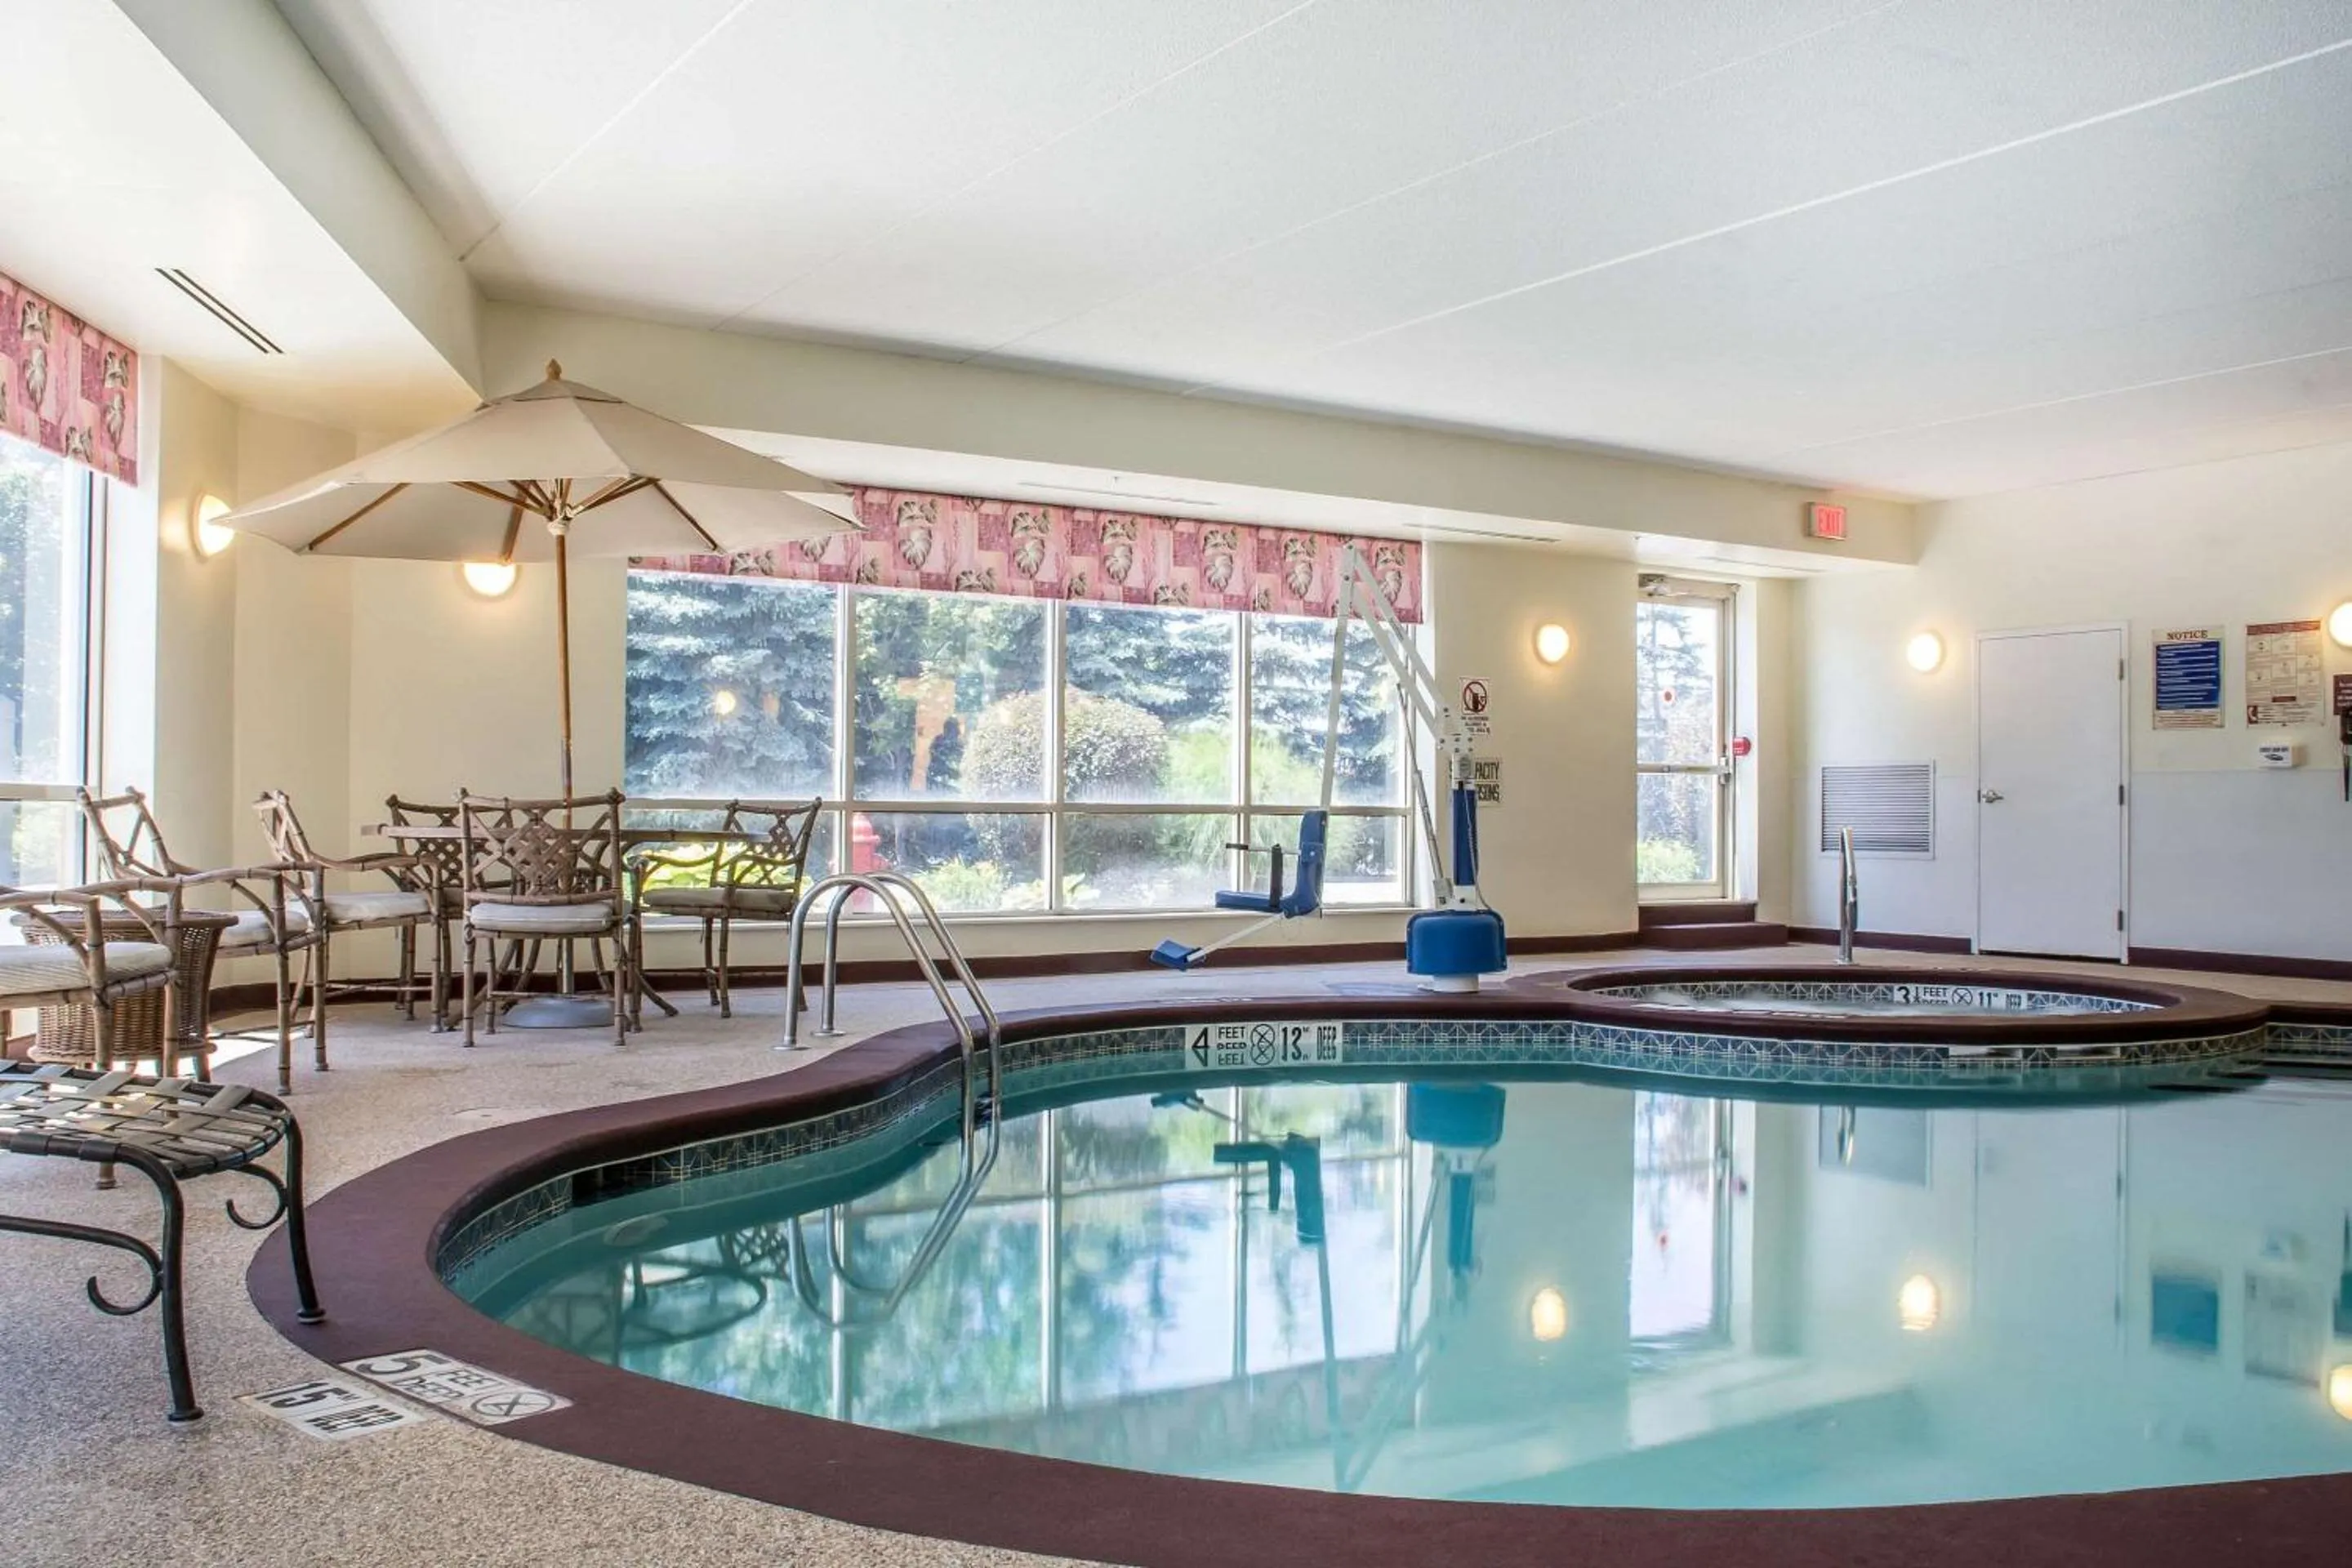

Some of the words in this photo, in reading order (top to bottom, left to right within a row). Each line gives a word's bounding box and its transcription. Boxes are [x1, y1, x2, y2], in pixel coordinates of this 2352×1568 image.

[1817, 508, 1842, 534] EXIT
[2167, 630, 2208, 641] NOTICE
[1923, 987, 1949, 997] FEET
[1192, 1027, 1210, 1049] 4
[1218, 1027, 1245, 1039] FEET
